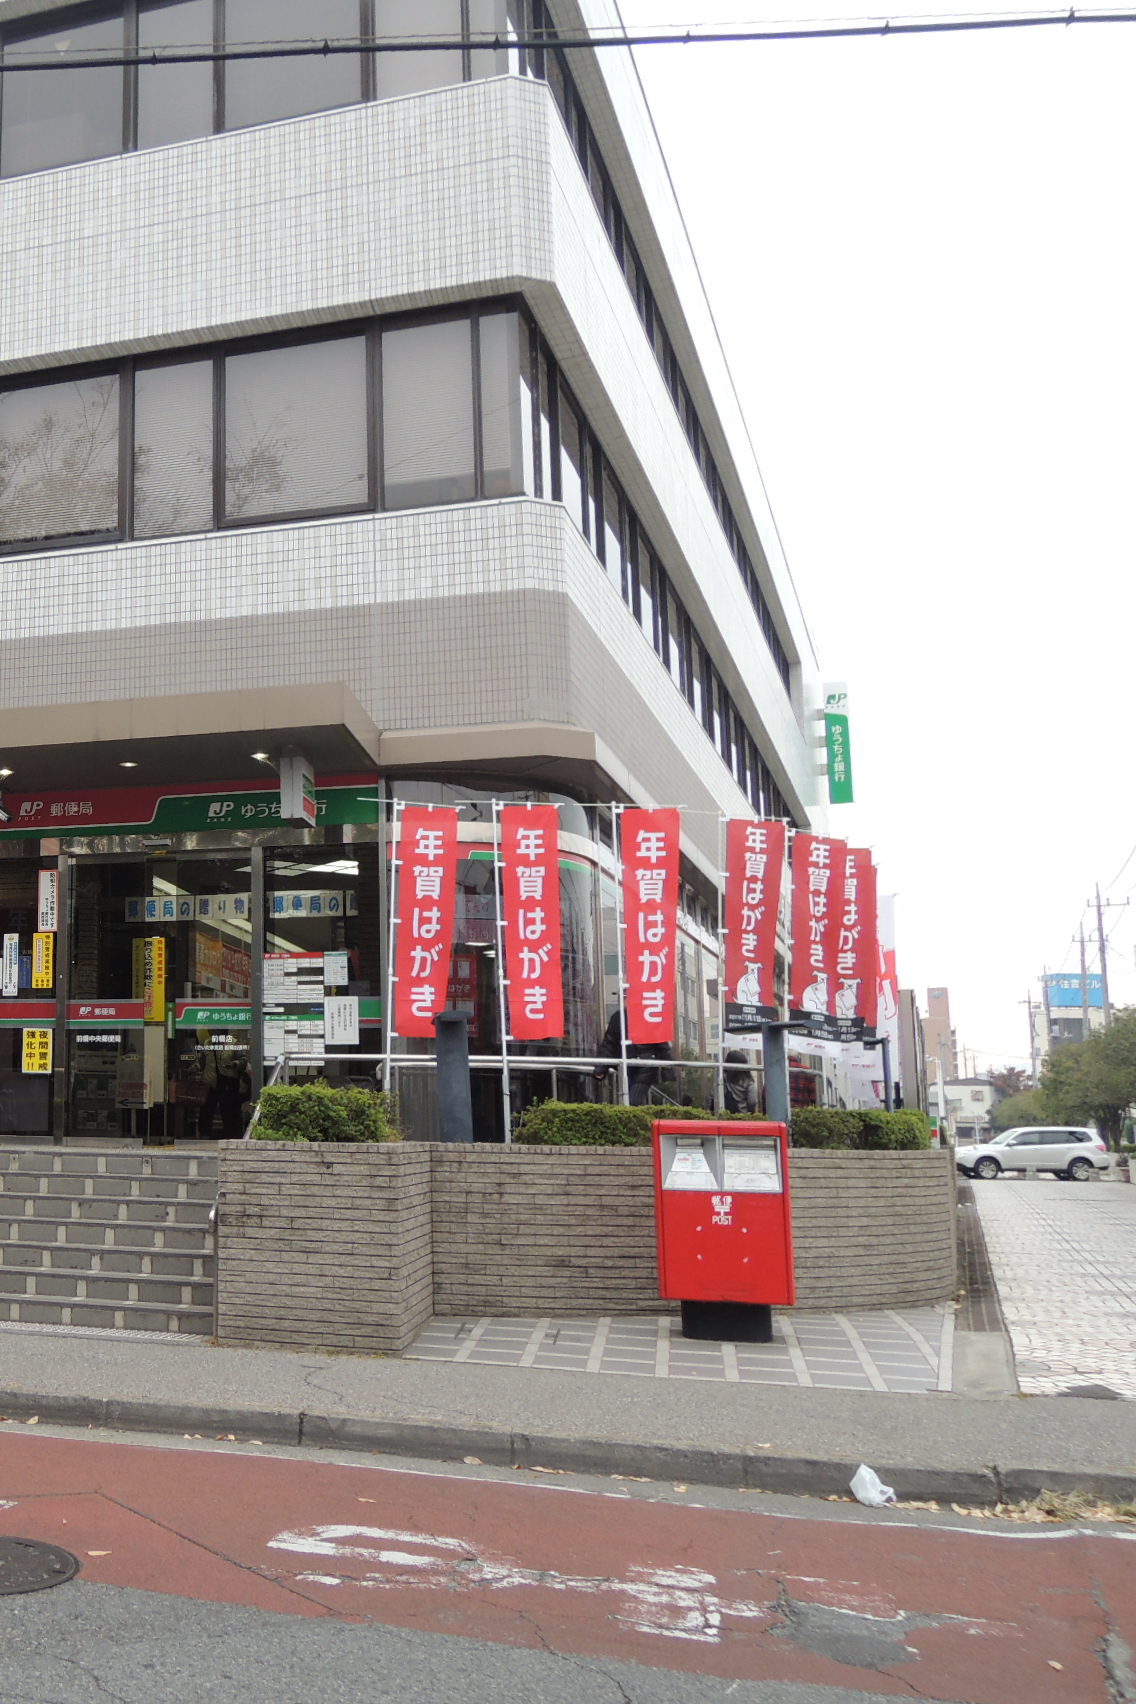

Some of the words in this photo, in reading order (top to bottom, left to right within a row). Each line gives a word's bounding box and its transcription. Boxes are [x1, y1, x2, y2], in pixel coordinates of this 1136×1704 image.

[832, 725, 845, 783] ゆうちょ銀行
[49, 801, 93, 817] 郵便局
[241, 800, 327, 818] ゆうち行
[740, 826, 767, 958] 年賀はがき
[808, 841, 830, 968] 年賀はがき
[410, 828, 443, 1018] 年賀はがき
[516, 827, 552, 1020] 年賀はがき
[635, 829, 670, 1023] 年賀はがき
[212, 1012, 252, 1021] ゆうちょ銀行
[38, 1030, 49, 1072] 夜間警戒
[711, 1215, 733, 1225] POST
